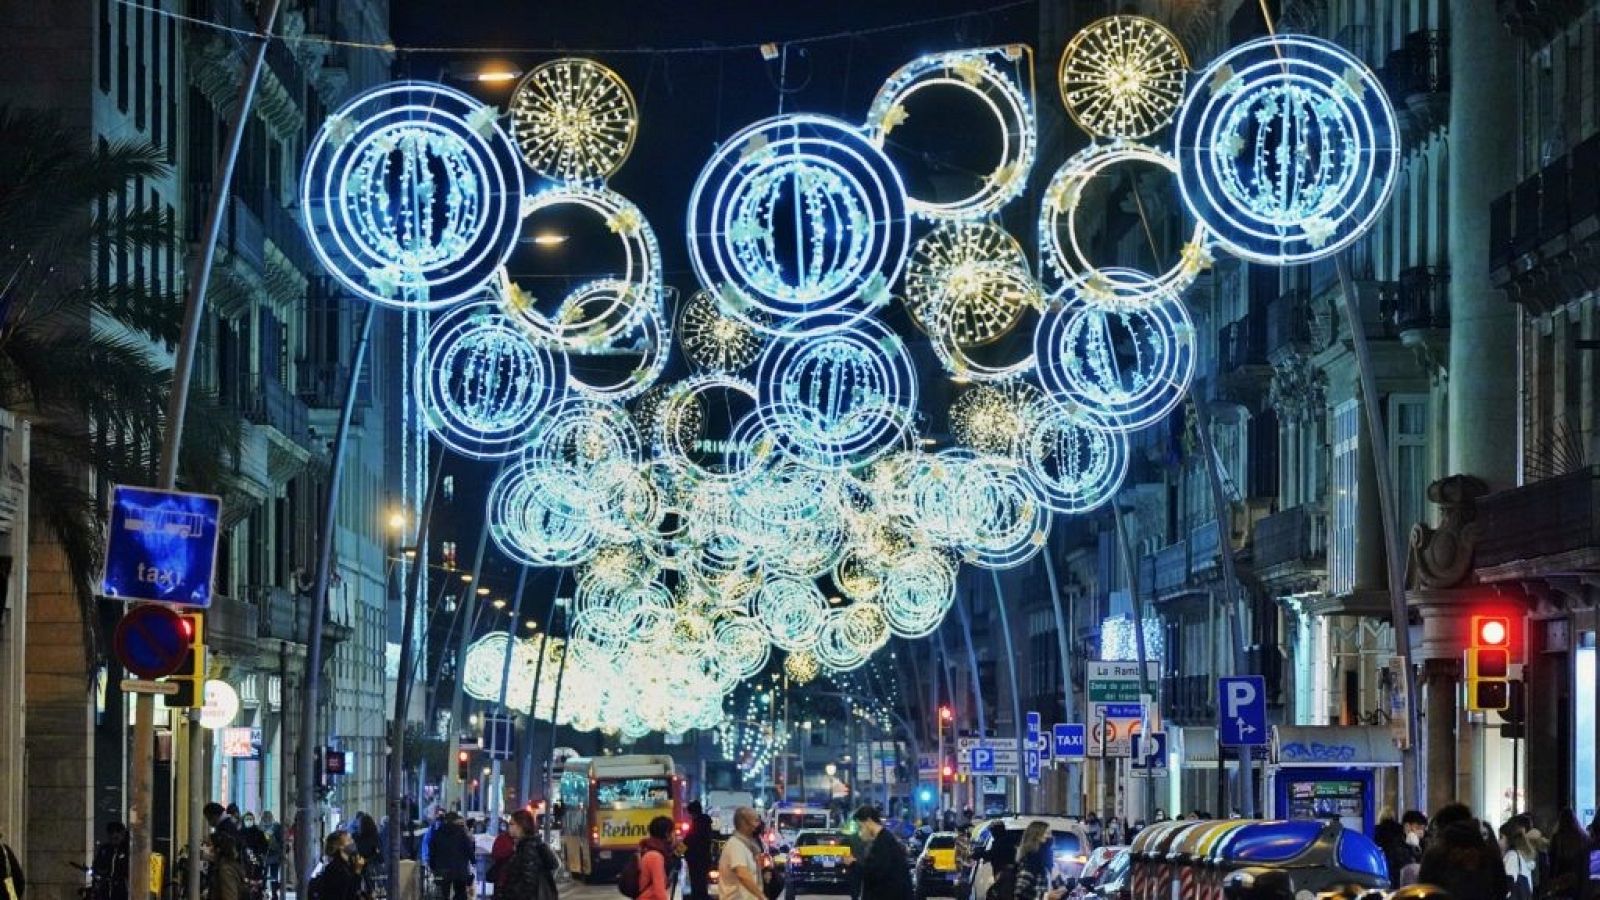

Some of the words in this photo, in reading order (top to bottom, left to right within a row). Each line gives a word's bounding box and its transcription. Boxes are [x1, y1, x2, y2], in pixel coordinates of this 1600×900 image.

[138, 562, 182, 586] taxi
[1227, 682, 1256, 718] P
[1056, 735, 1083, 746] TAXI
[974, 749, 990, 769] P
